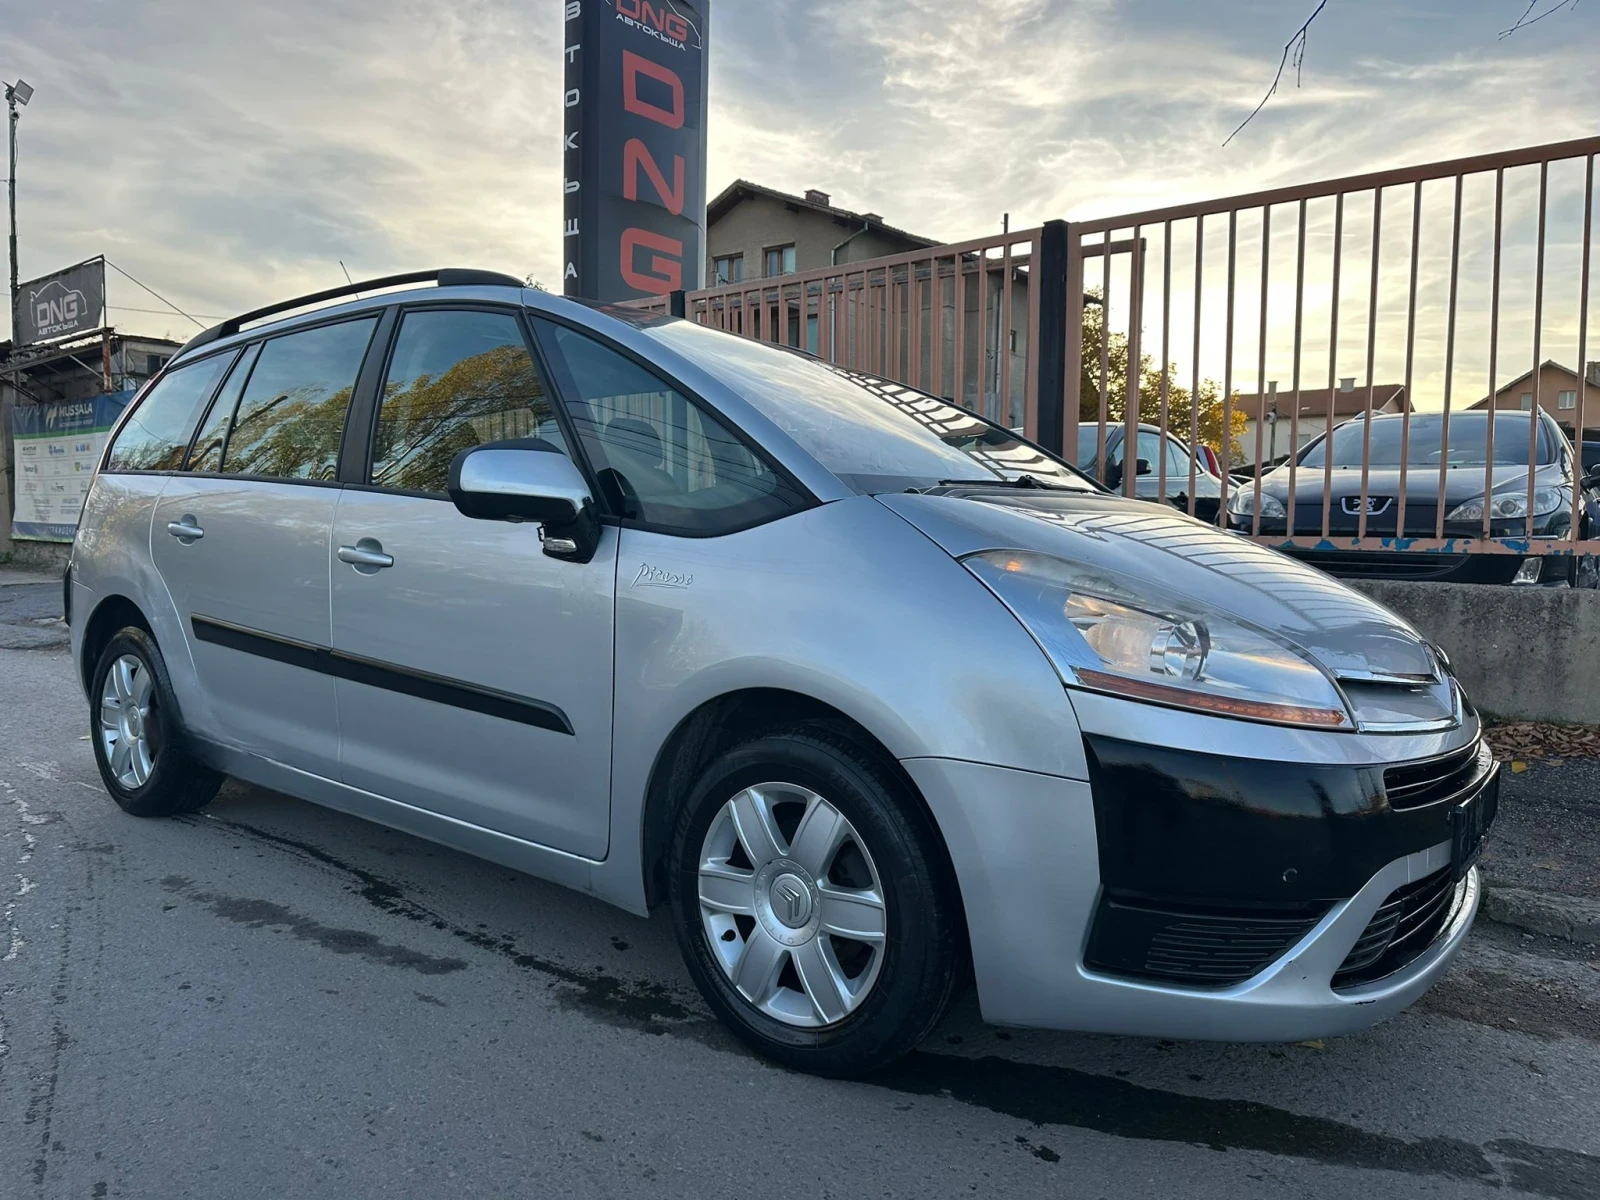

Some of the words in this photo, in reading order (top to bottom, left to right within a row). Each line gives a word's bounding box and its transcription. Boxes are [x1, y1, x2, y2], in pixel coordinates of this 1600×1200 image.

[616, 0, 687, 42] DNG
[36, 293, 78, 328] DNG
[59, 402, 93, 417] MUSSALA
[630, 562, 694, 590] Picasso
